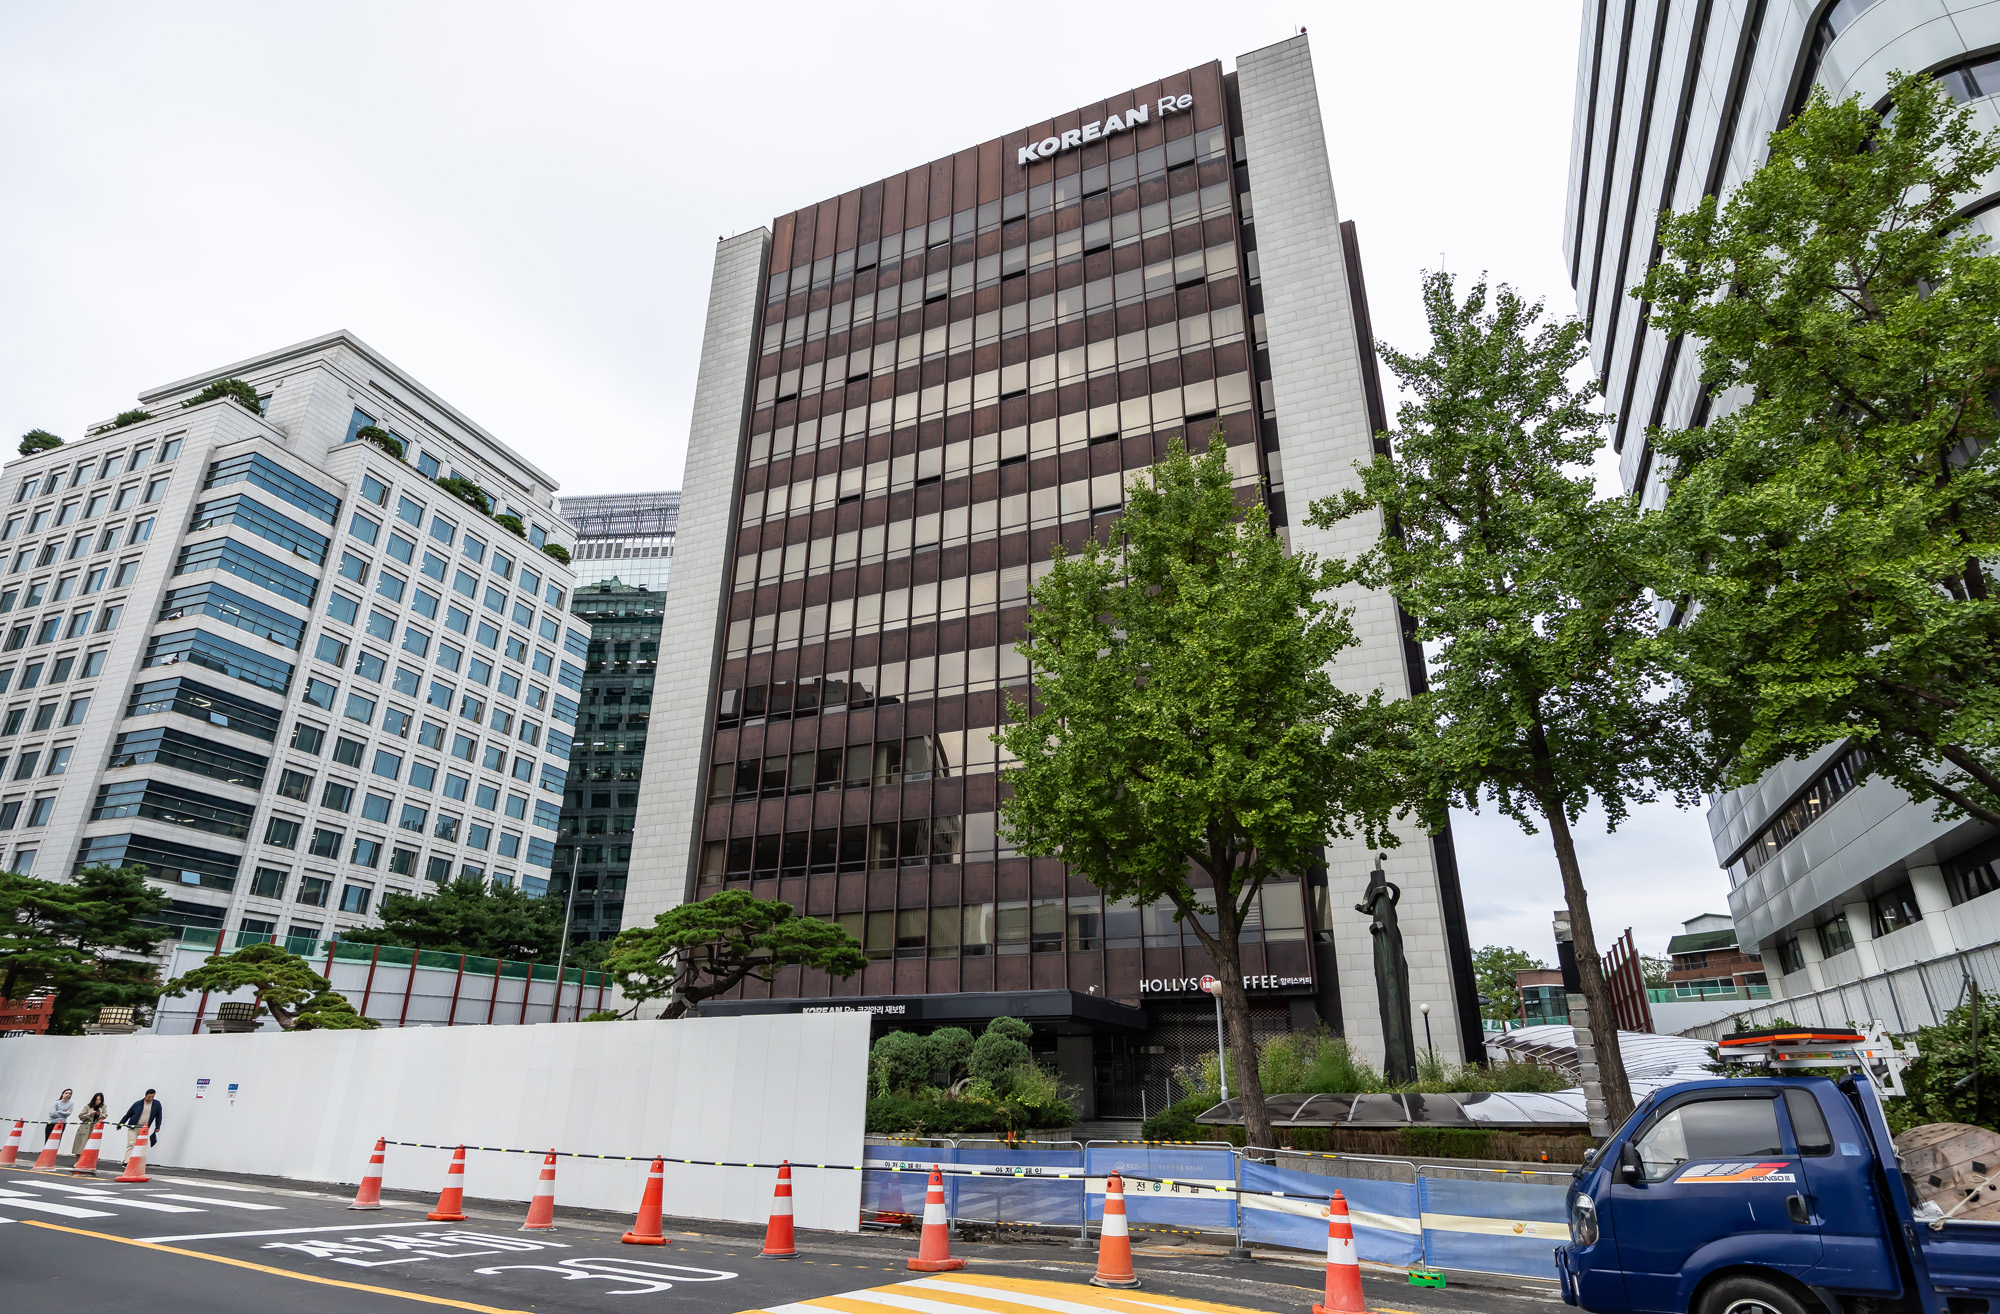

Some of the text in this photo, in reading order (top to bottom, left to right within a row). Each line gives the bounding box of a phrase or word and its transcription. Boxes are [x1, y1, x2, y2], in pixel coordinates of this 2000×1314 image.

[1018, 93, 1193, 165] KOREAN Re
[1139, 975, 1279, 992] HOLLYS FFEE
[1280, 976, 1312, 986] 할리스커피
[885, 1005, 905, 1014] 재보험
[259, 1229, 573, 1267] 천천히
[473, 1257, 739, 1295] 30
